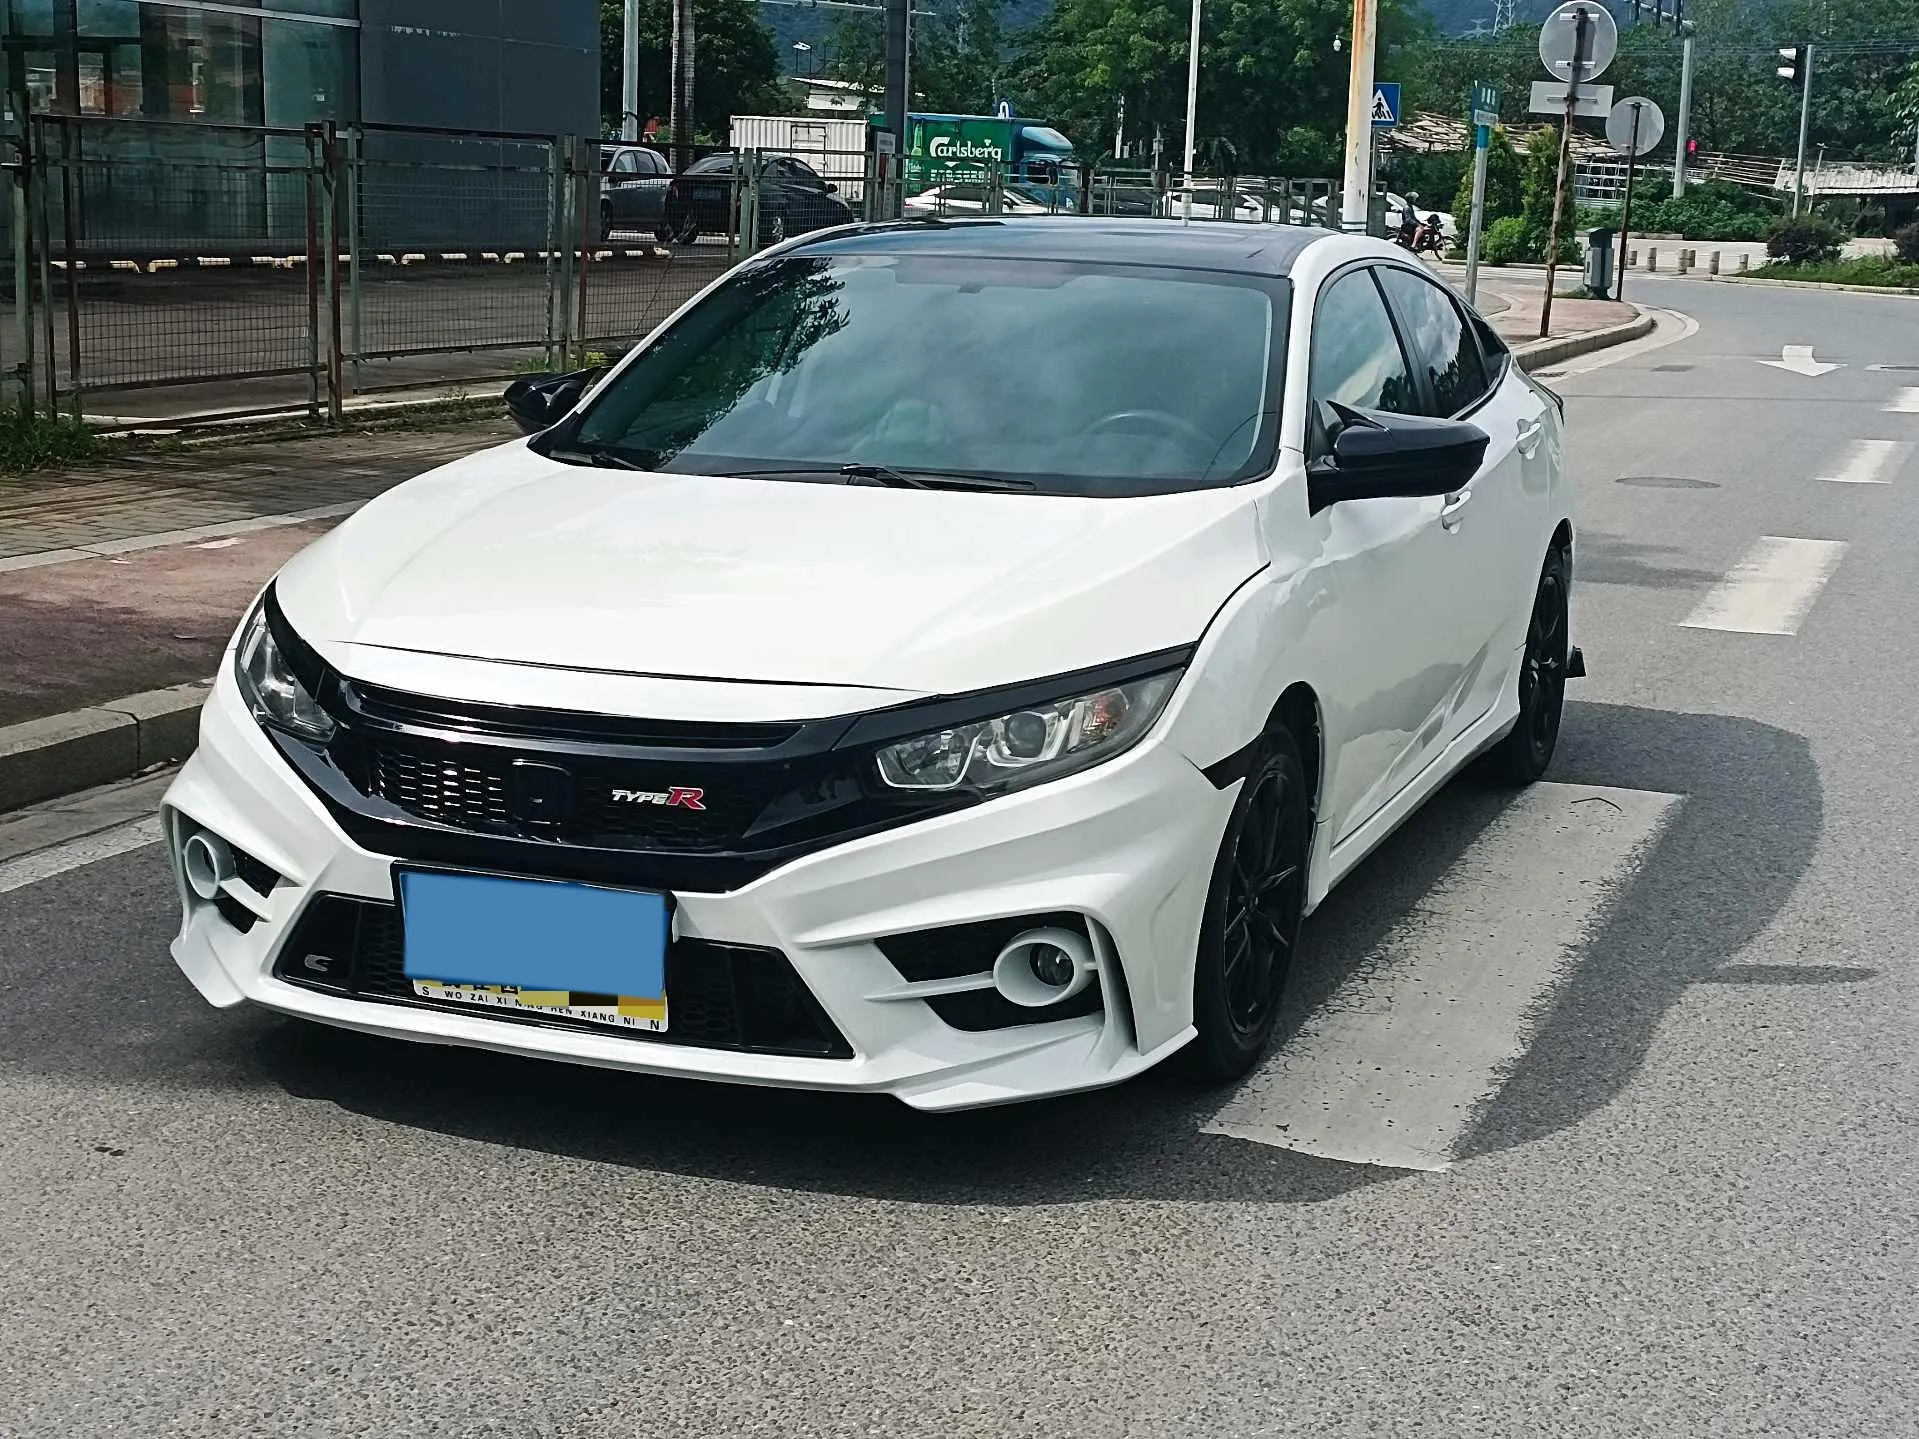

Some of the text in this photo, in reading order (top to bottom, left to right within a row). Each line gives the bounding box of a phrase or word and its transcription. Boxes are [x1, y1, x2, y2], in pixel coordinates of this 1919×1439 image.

[929, 136, 1002, 162] Carlsberg
[444, 990, 462, 999] WO
[470, 993, 488, 1002] ZAI
[496, 996, 507, 1005] XI
[580, 1010, 615, 1023] XIANG
[623, 1016, 635, 1026] NI
